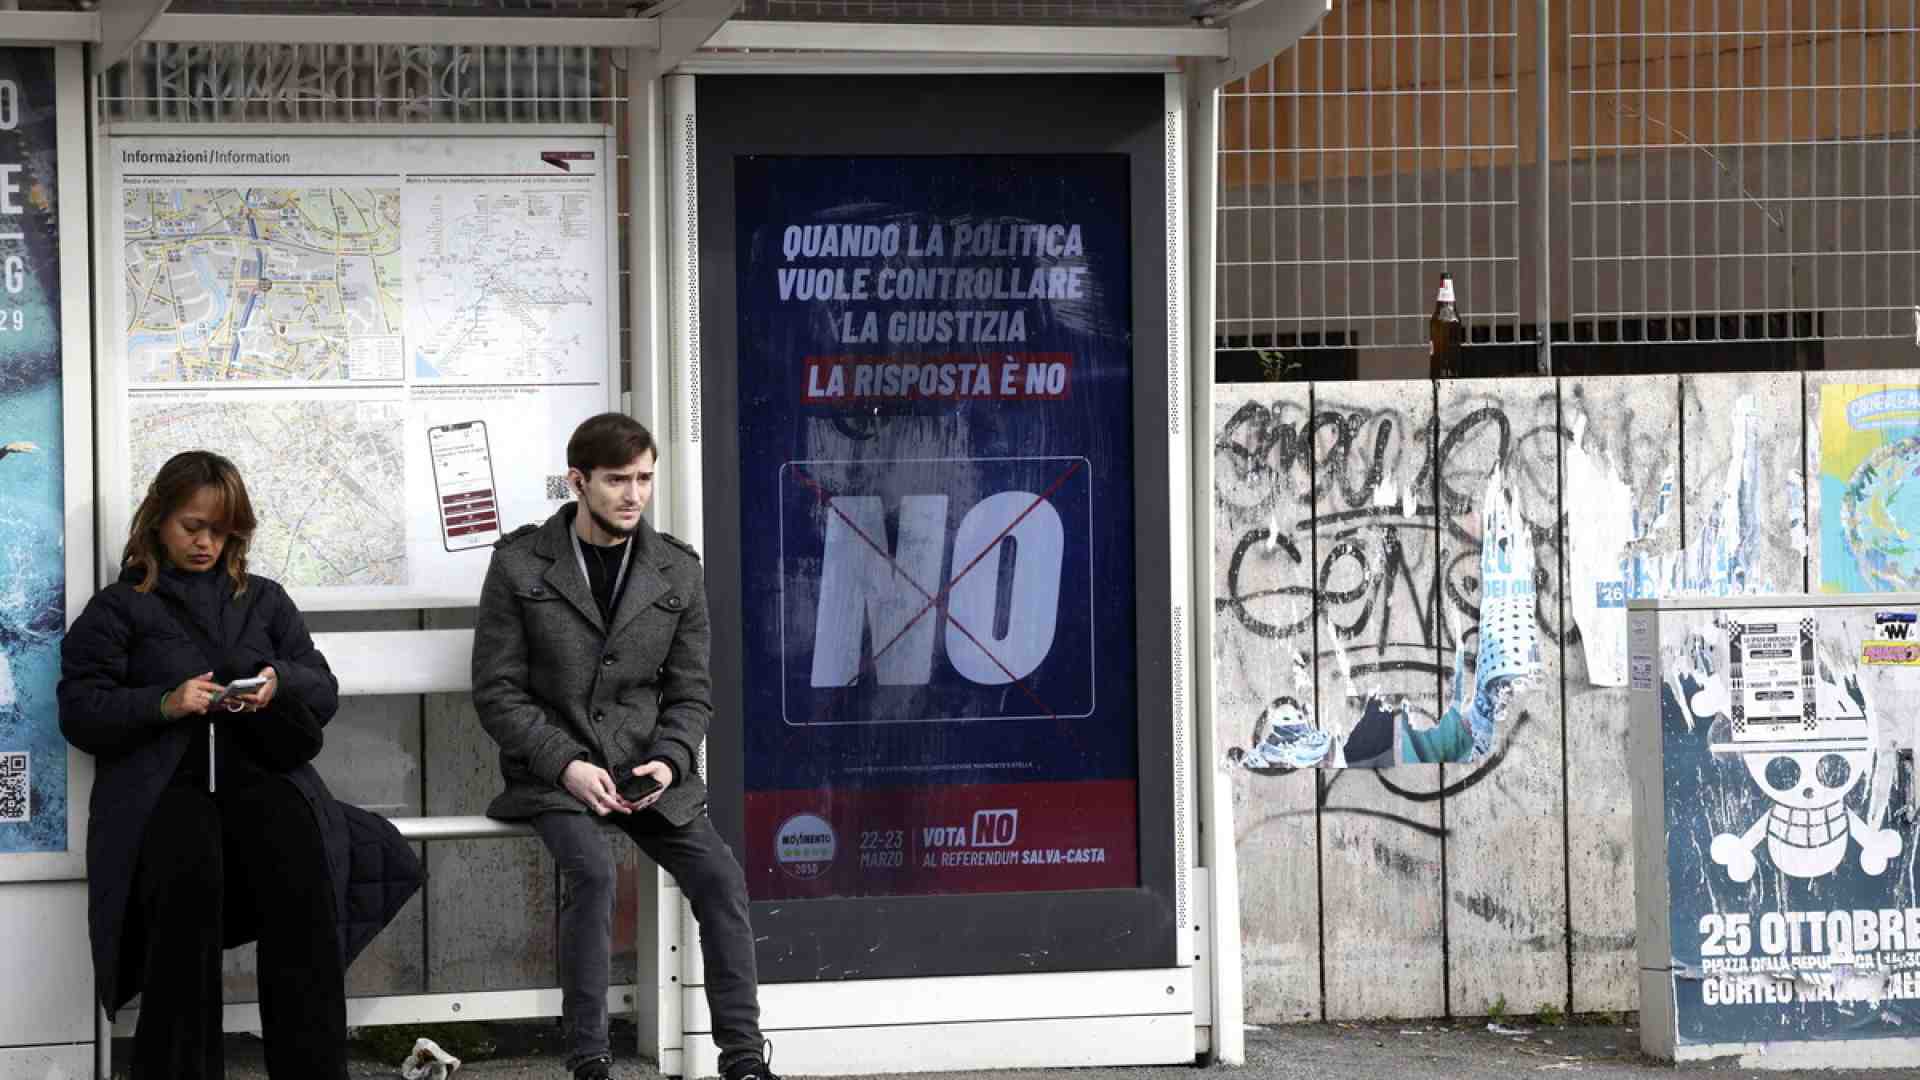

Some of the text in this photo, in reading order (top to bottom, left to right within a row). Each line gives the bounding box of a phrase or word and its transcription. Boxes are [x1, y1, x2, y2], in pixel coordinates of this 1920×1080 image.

[122, 150, 290, 164] Informazioni/Information
[783, 223, 1084, 261] QUANDO LA POLITICA
[777, 266, 1084, 301] VUOLE CONTROLLARE
[841, 310, 1026, 344] LA GIUSTIZIA
[808, 355, 1066, 397] LA RISPOSTA È NO
[810, 490, 1065, 689] NO
[859, 826, 967, 849] 22-23 VOTA
[974, 811, 1015, 845] NO
[860, 847, 1105, 868] MARZO AL REFERENDUM SALVA-CASTA
[1699, 907, 1920, 957] 25 OTTOBRE
[1702, 956, 1748, 974] PIAZZA
[1751, 955, 1788, 972] DELLA
